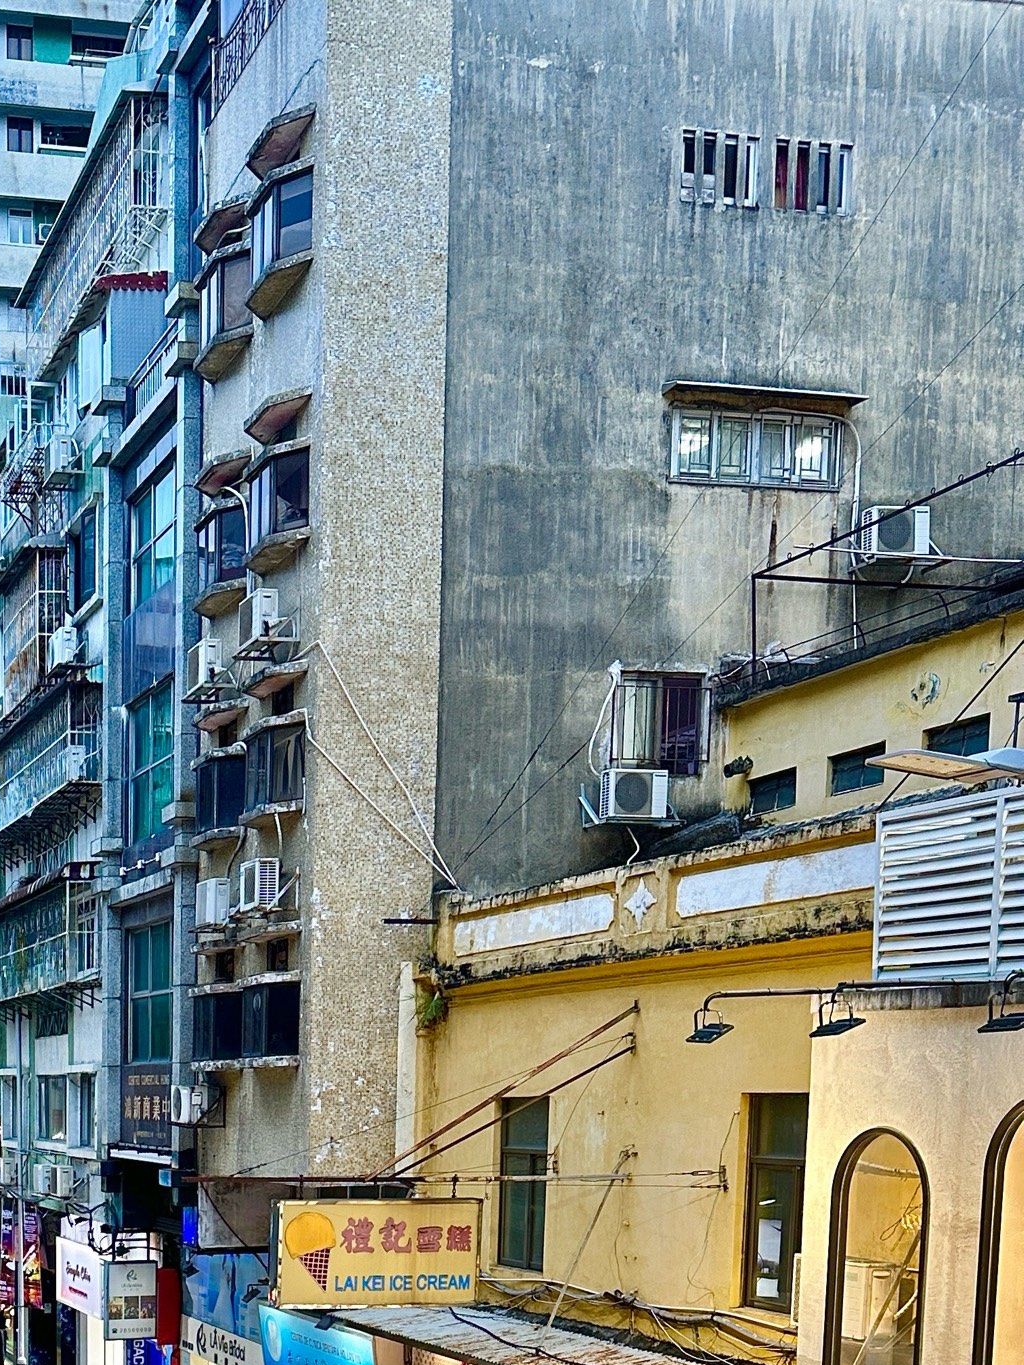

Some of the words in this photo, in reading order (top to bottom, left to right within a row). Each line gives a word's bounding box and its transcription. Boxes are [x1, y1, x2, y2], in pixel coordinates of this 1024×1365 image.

[340, 1217, 471, 1254] 禮記雪糕
[335, 1275, 358, 1292] LAI
[362, 1275, 385, 1292] KEI
[390, 1275, 413, 1291] ICE
[416, 1274, 471, 1291] CREAM
